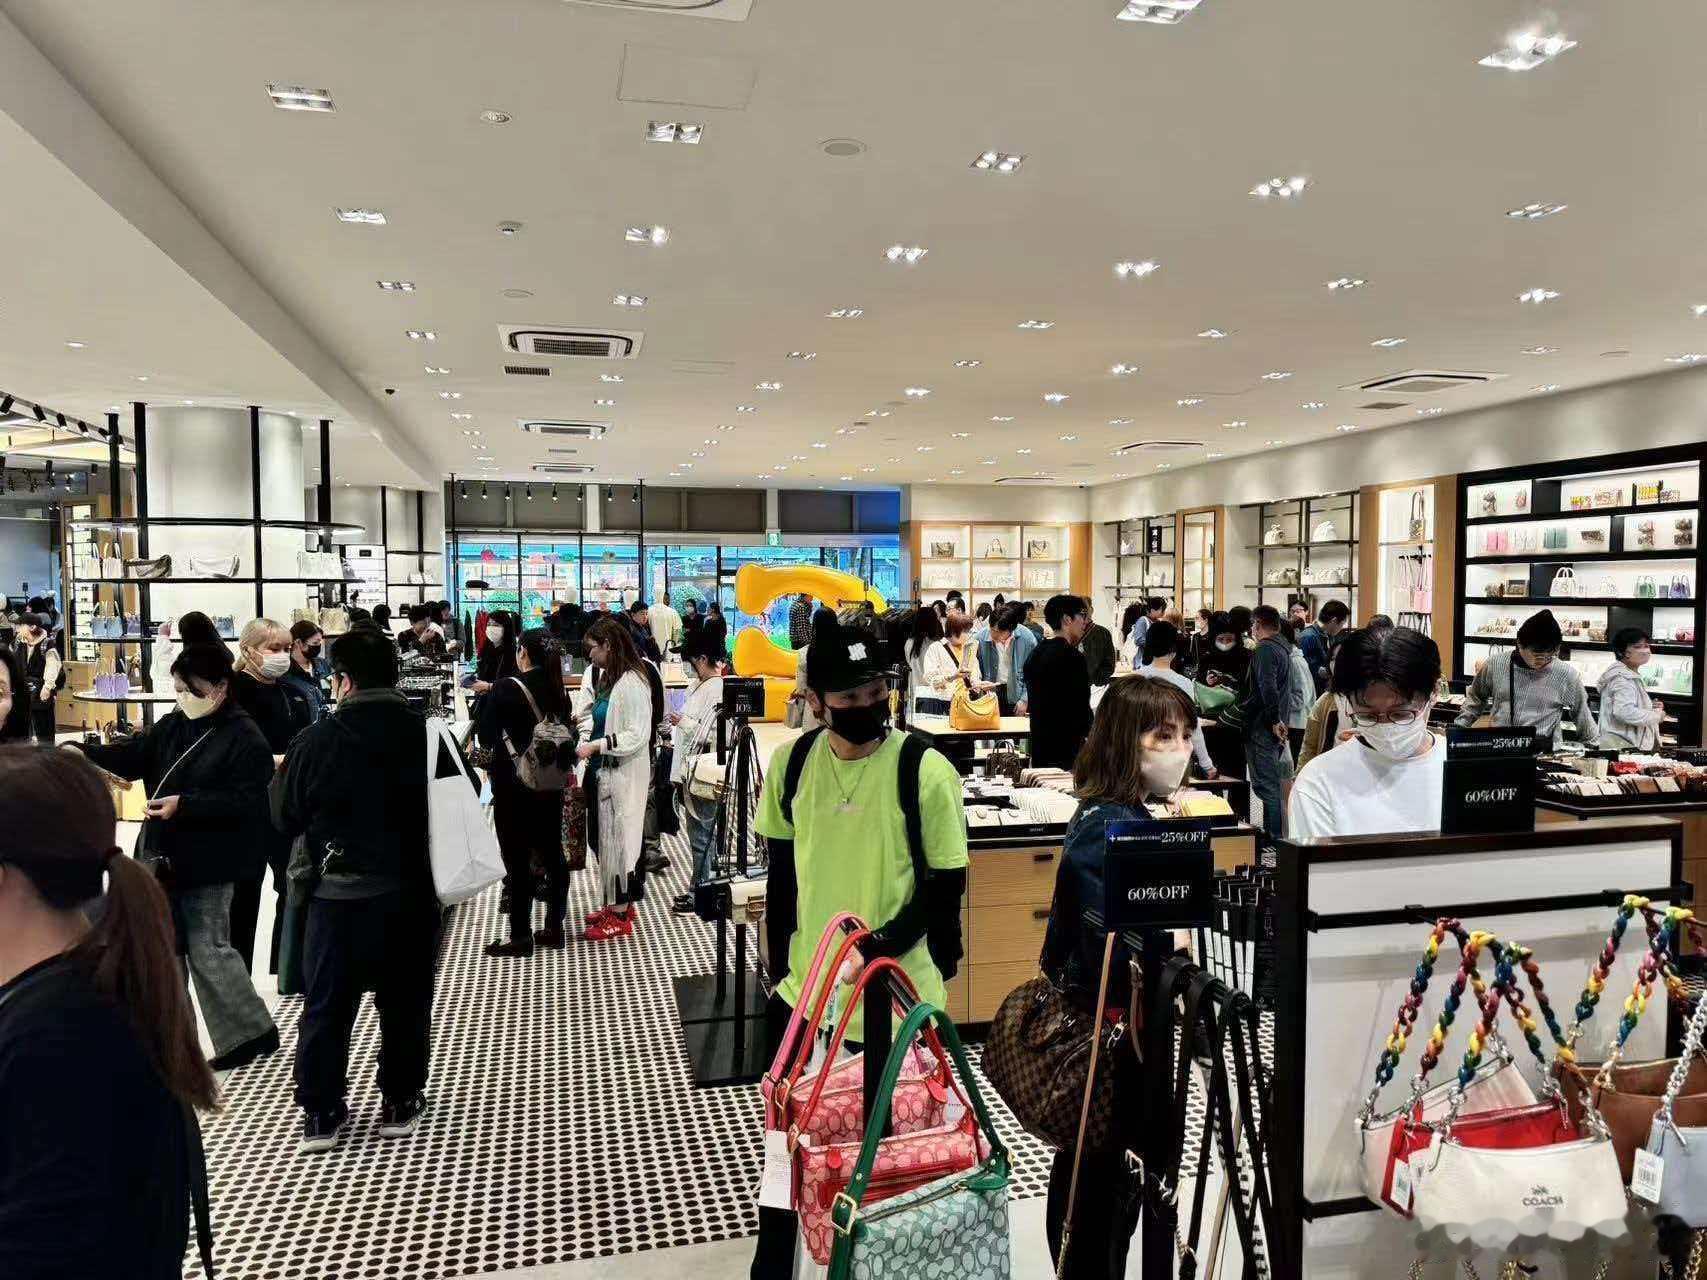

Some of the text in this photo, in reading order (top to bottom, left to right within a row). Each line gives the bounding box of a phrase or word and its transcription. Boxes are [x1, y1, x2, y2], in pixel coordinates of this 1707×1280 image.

[1492, 737, 1533, 749] 25%OFF
[1465, 787, 1518, 803] 60%OFF
[1161, 831, 1208, 843] 25%OFF
[1127, 885, 1190, 901] 60%OFF
